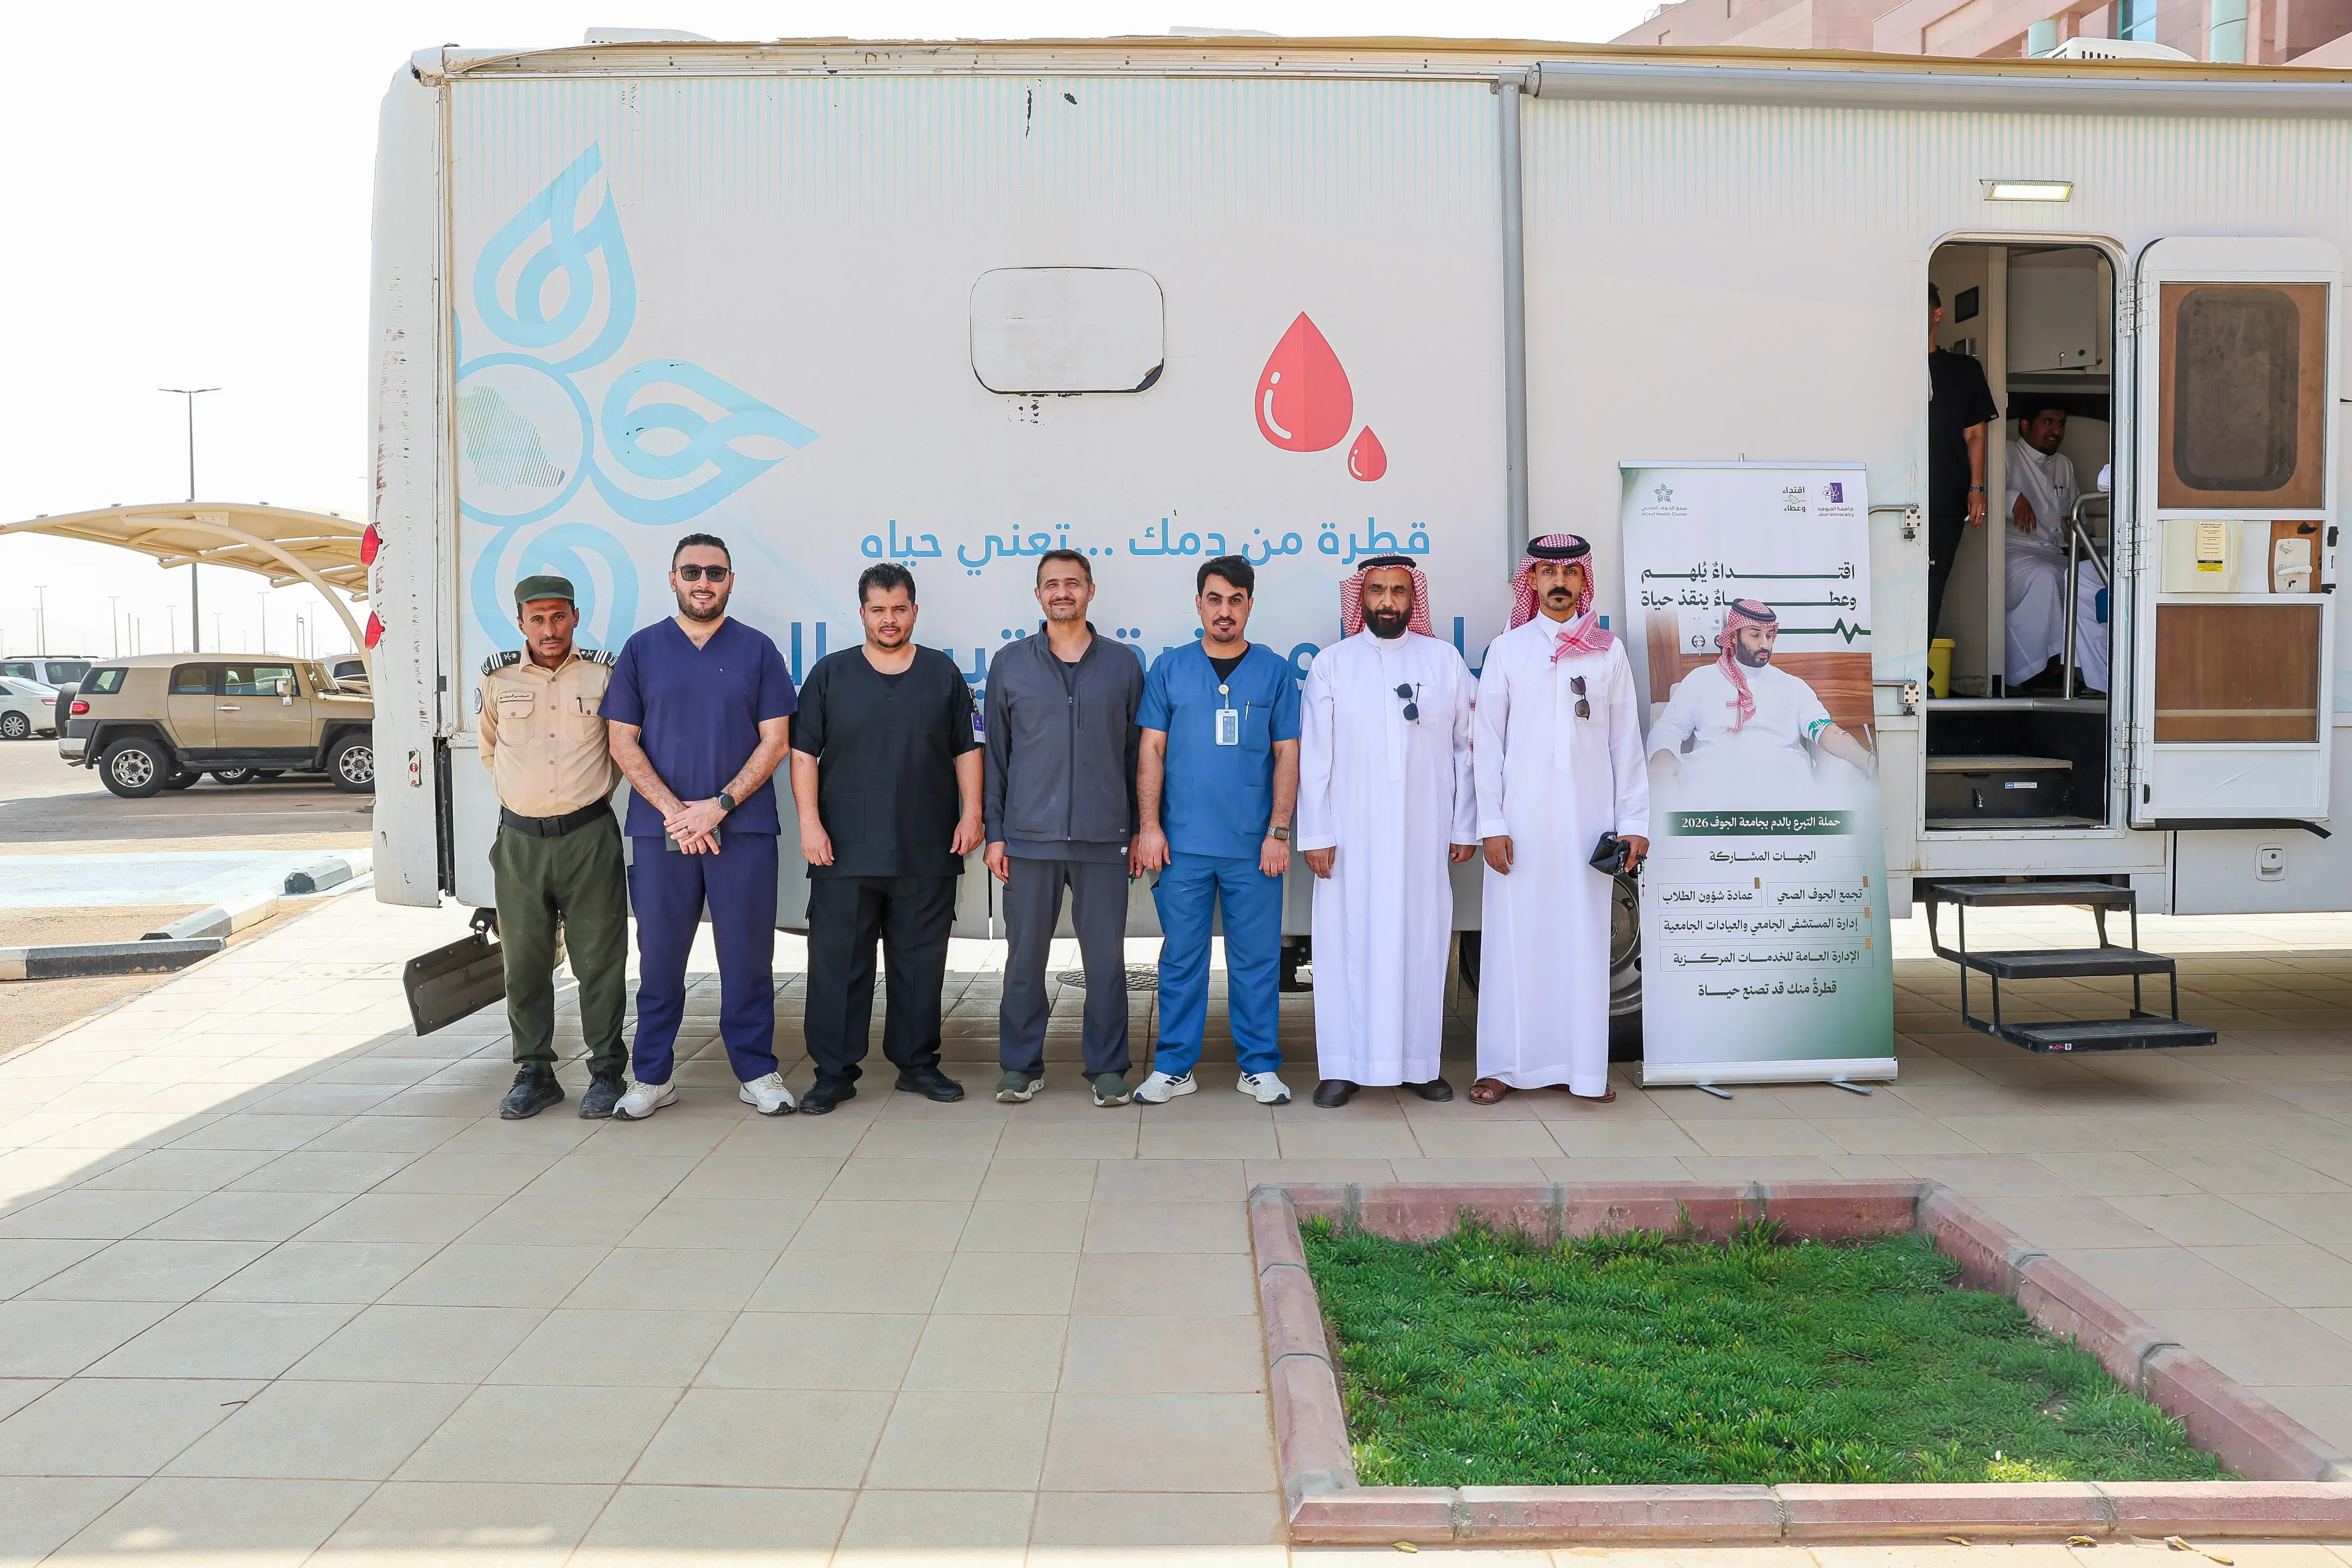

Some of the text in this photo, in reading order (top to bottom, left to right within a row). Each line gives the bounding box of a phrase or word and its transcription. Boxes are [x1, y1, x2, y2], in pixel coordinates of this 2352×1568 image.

[861, 521, 942, 566] حياه
[1129, 519, 1225, 556] دمك
[1319, 517, 1429, 564] قطرة
[1242, 529, 1302, 565] من
[1641, 590, 1674, 611] حياة
[1678, 588, 1709, 611] ينقذ
[1682, 816, 1841, 831] حملة التبرع بالدم بجامعة الجوف 2026
[1710, 850, 1816, 864] الجهات المشاركة
[1662, 890, 1753, 904] عمادة شؤون الطلاب
[1777, 887, 1863, 905] تجمع الجوف الصحي
[1664, 917, 1859, 936] إدارة المستشفى الجامعي والعيادات الجامعية
[1673, 950, 1859, 967] الإدارة العامة للخدمات المركزية
[1698, 984, 1740, 1000] حياة
[1743, 983, 1769, 1000] تصنع
[1772, 981, 1784, 994] قد
[1787, 982, 1810, 994] منك
